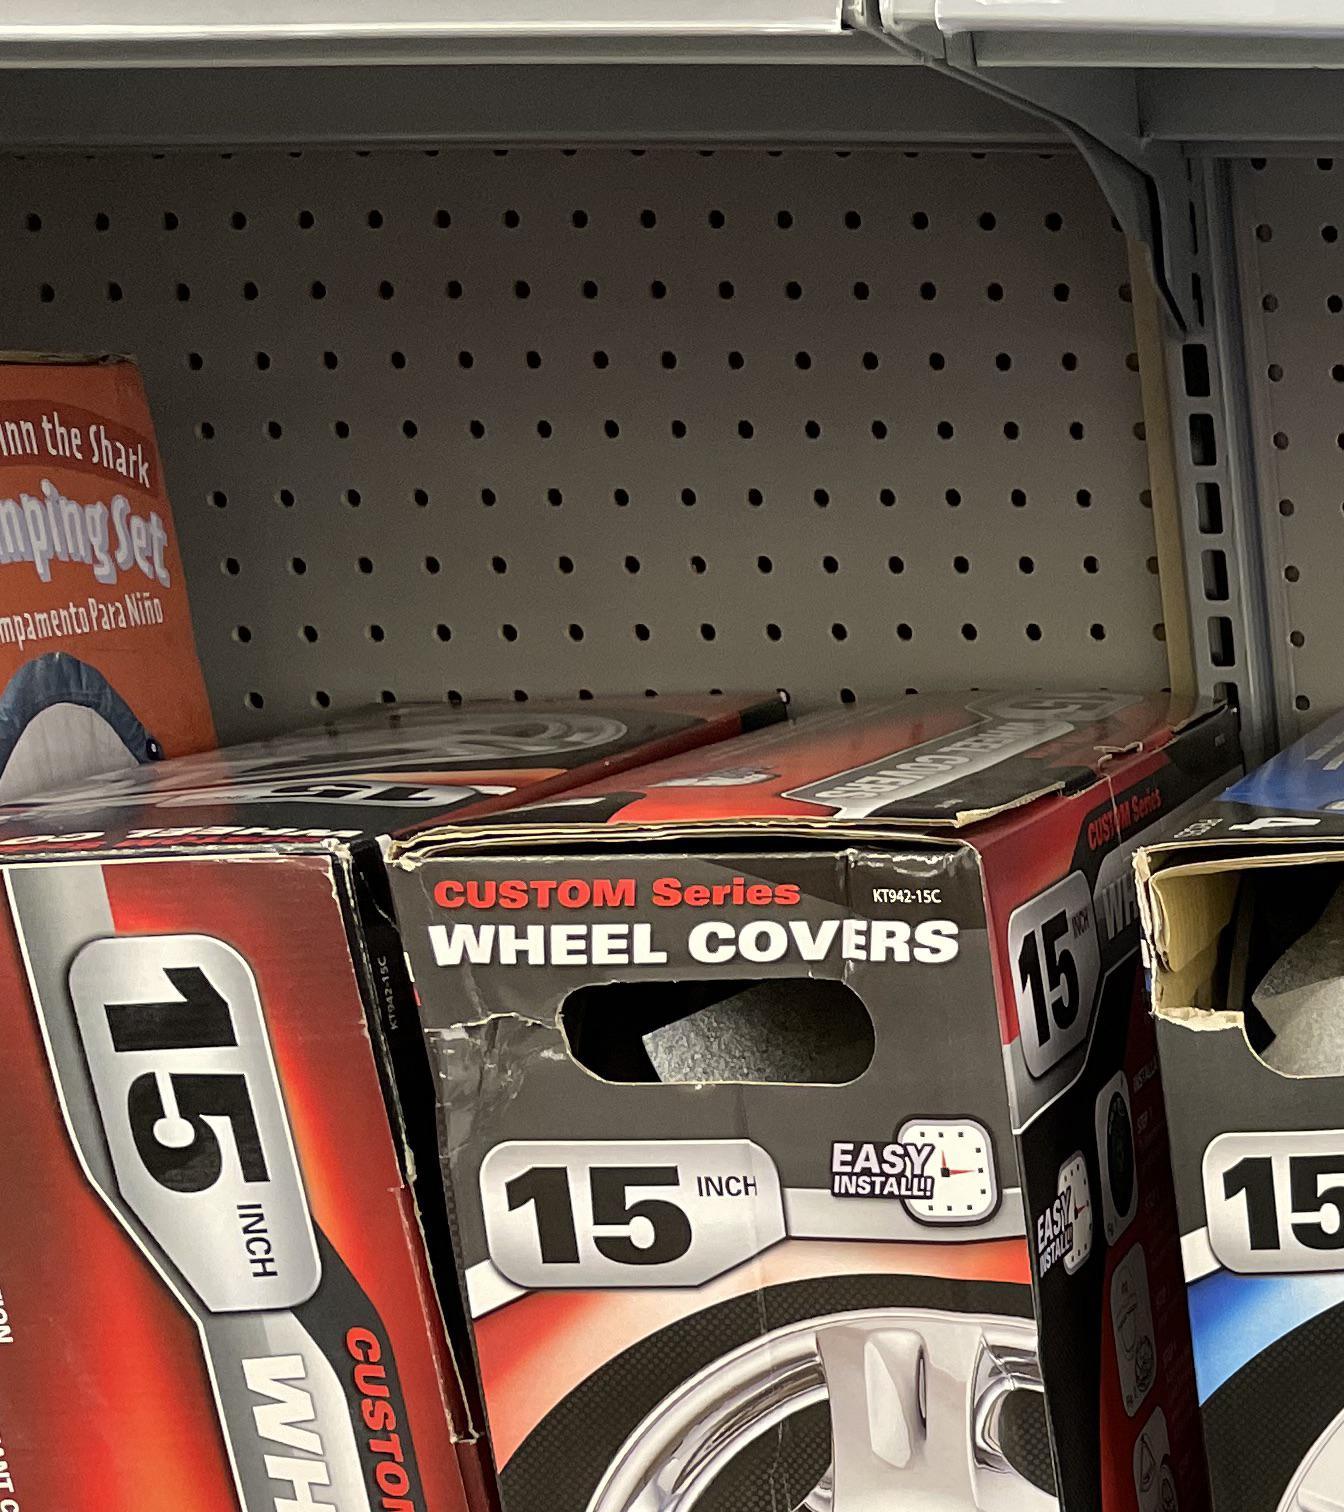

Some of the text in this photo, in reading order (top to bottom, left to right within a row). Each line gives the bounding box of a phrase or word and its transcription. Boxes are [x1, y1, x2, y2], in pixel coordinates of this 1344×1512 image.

[42, 411, 150, 489] the Shark
[111, 494, 170, 588] Set
[88, 591, 163, 630] Para Niño
[433, 876, 800, 909] CUSTOM Series
[873, 888, 941, 906] KT942-15C
[428, 920, 959, 966] WHEEL COVERS
[104, 966, 278, 1278] 15 INCH
[831, 1143, 934, 1177] EASY
[505, 1166, 757, 1264] 15 INCH
